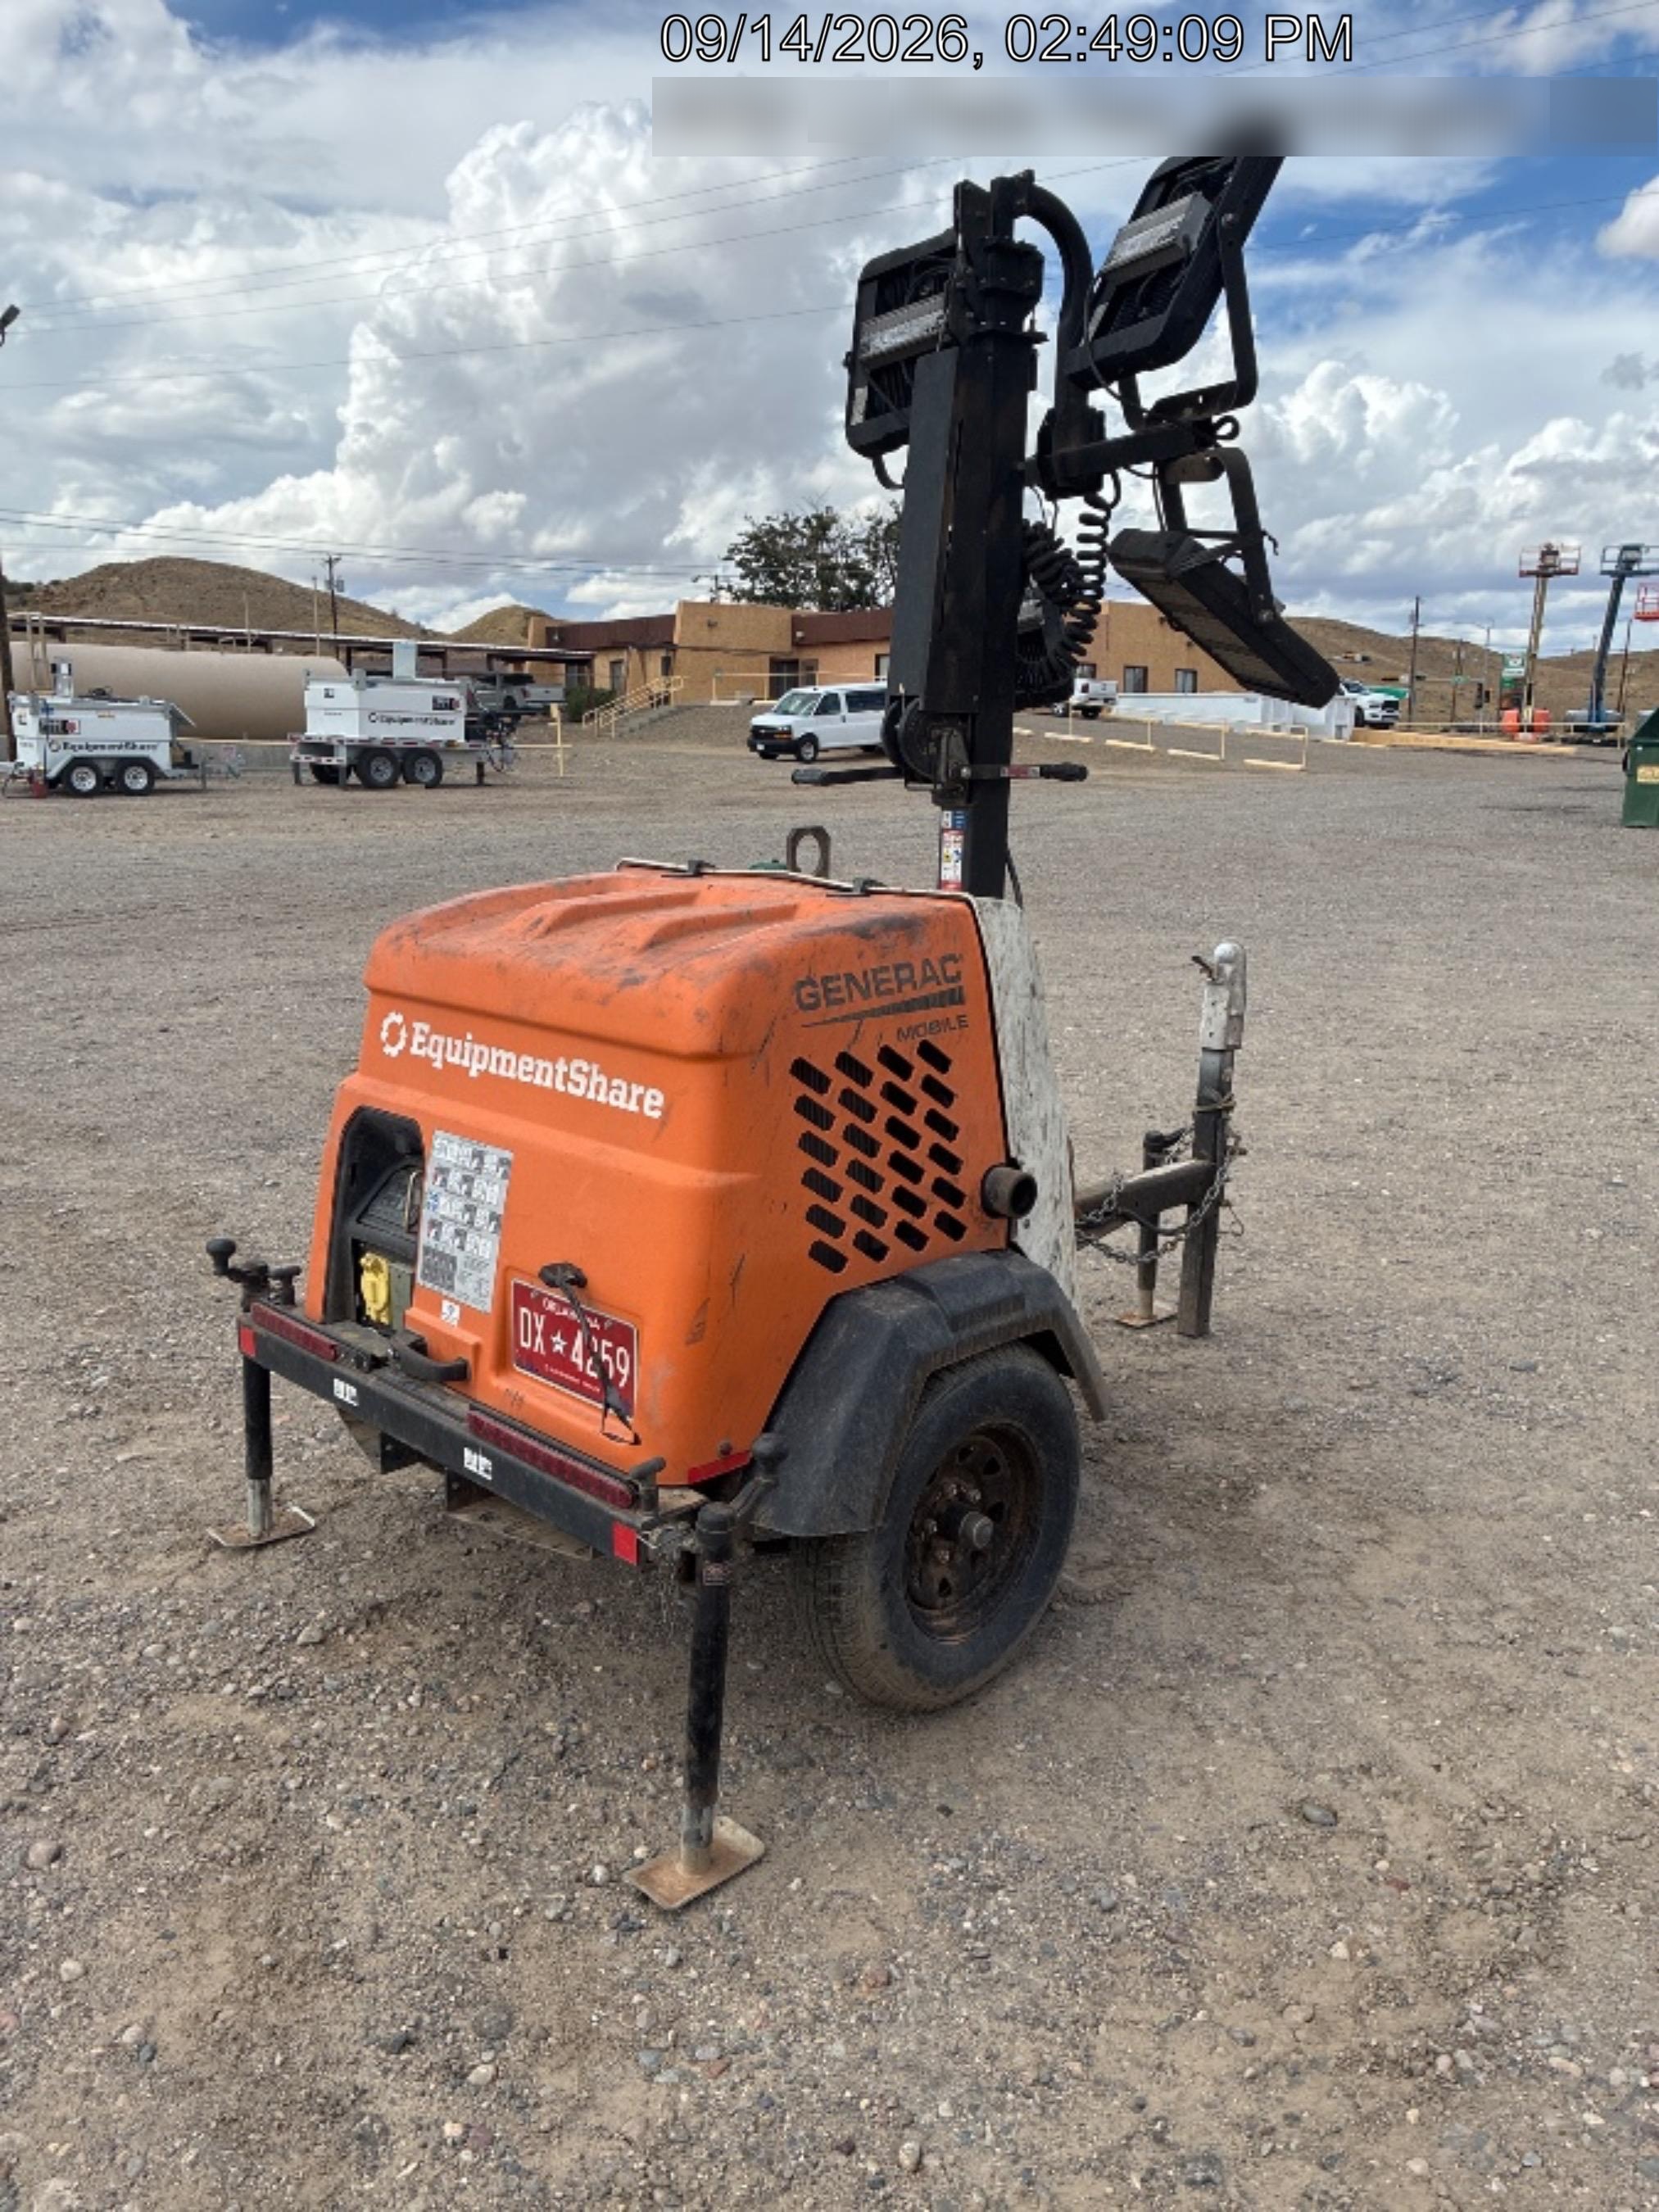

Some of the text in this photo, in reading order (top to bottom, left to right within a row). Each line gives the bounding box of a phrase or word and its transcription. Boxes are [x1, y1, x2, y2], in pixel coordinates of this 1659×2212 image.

[795, 953, 963, 1012] GENERAC
[897, 1014, 969, 1042] MOBILE
[410, 1021, 665, 1119] EquipmentShare
[519, 1306, 546, 1356] DX
